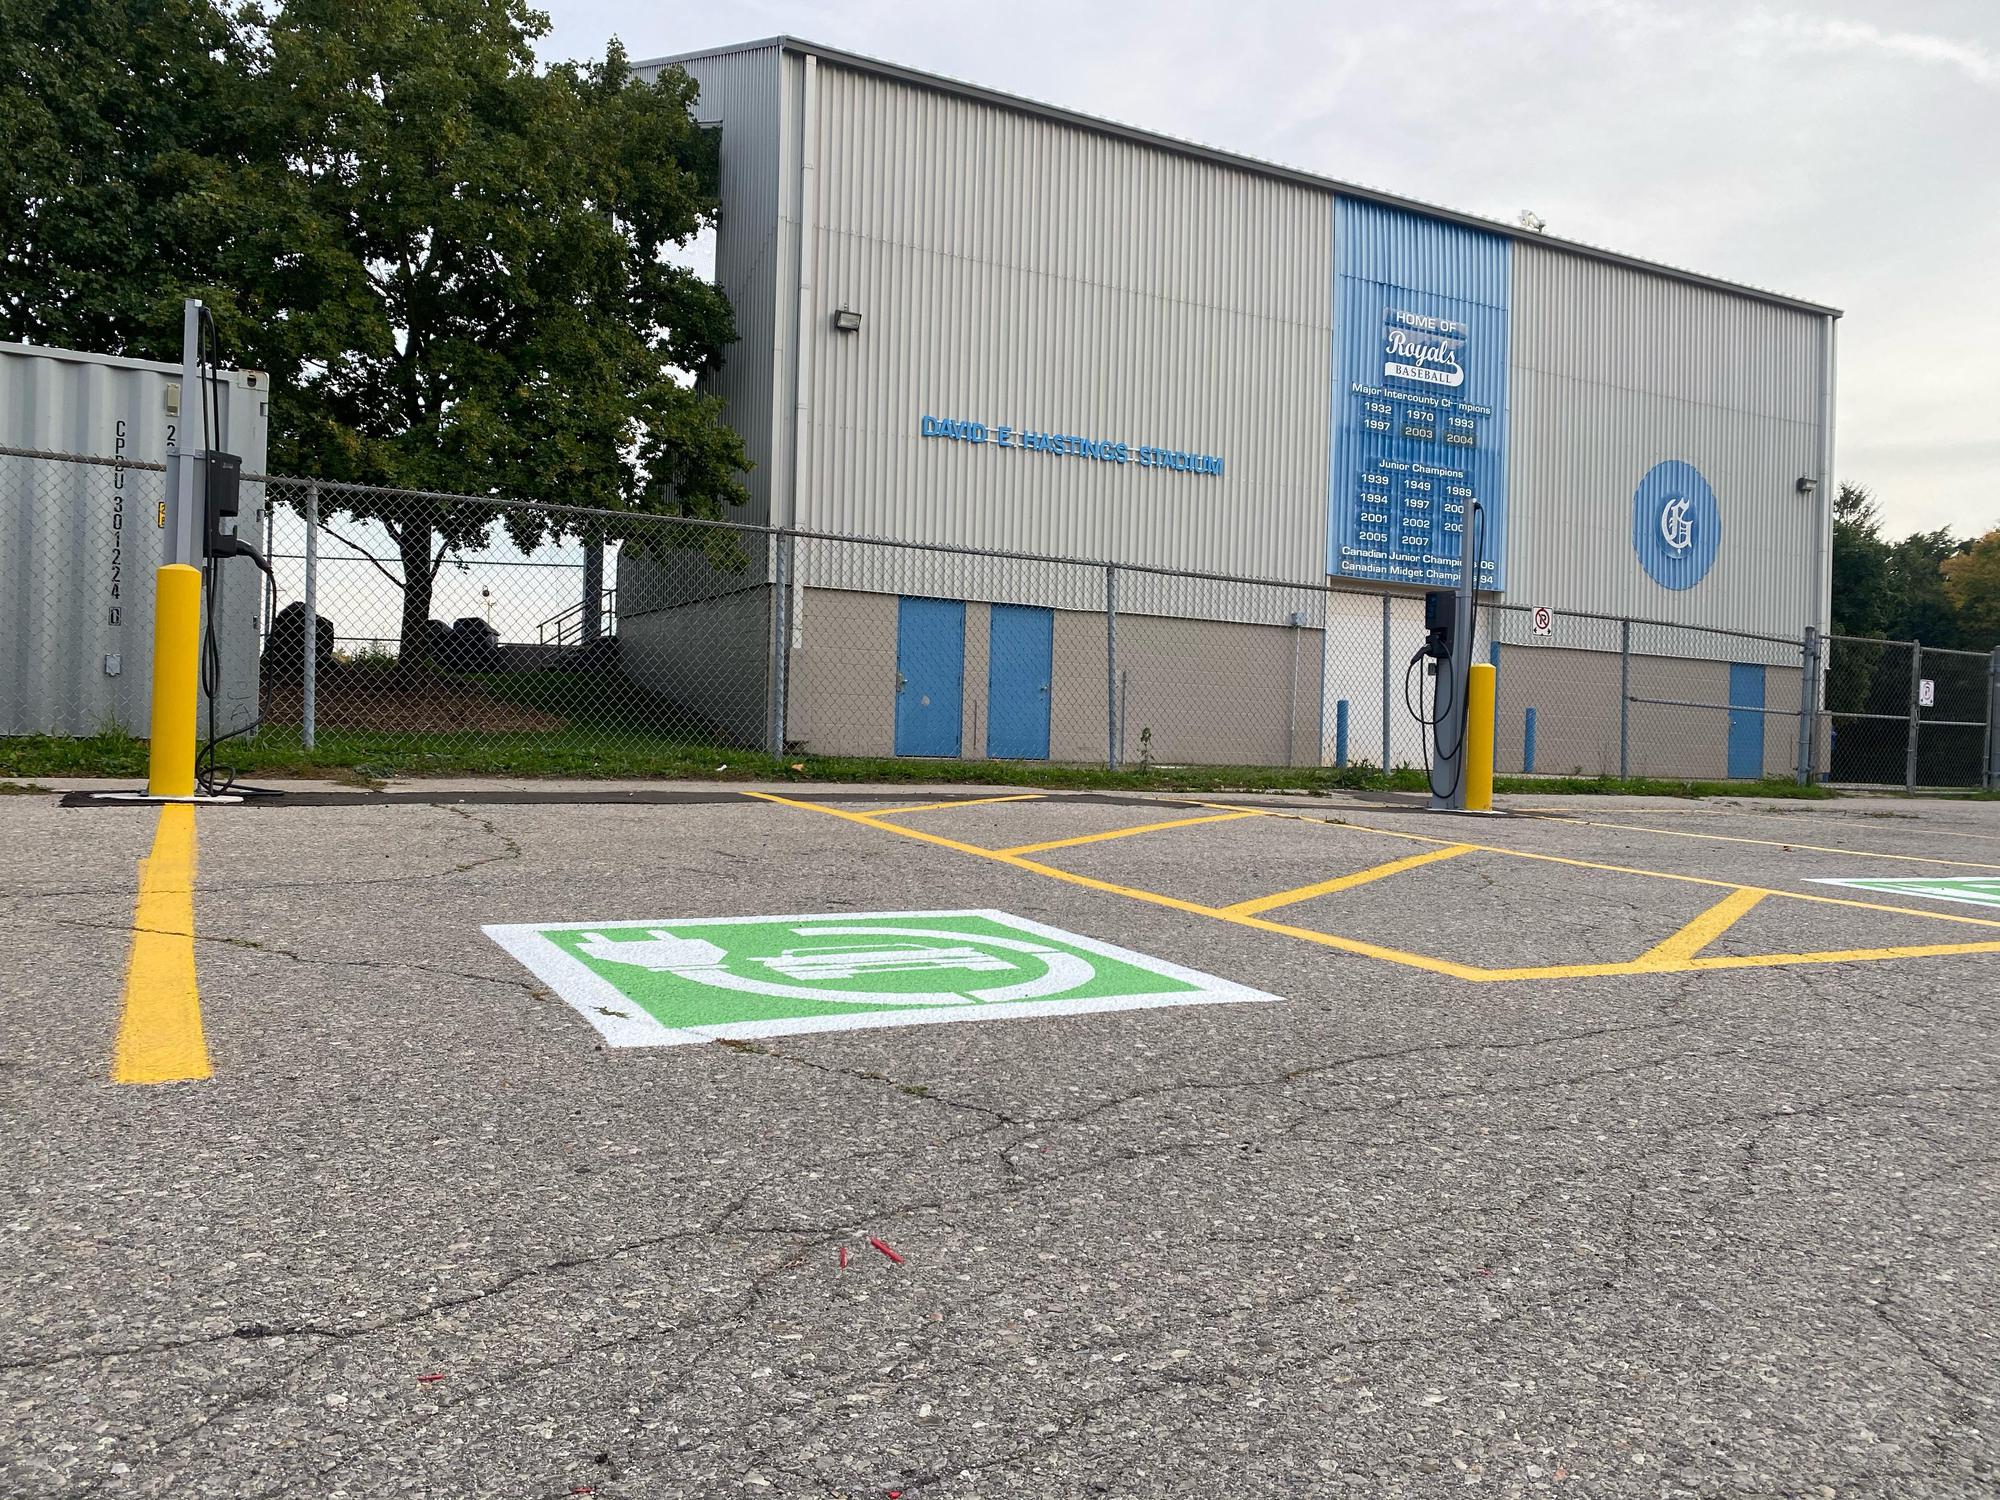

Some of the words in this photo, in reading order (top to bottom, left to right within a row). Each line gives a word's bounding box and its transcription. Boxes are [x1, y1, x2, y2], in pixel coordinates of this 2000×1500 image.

[1396, 312, 1436, 330] HOME
[1440, 320, 1457, 333] OF
[1386, 331, 1455, 366] Royals
[1395, 365, 1451, 383] BASEBALL
[1352, 383, 1382, 397] Major
[1384, 388, 1440, 408] Intercounty
[1441, 398, 1491, 415] Chmpions
[1364, 401, 1392, 415] 1932
[1406, 409, 1434, 422] 1970
[1448, 416, 1475, 430] 1993
[1364, 418, 1390, 431] 1997
[1405, 427, 1433, 439] 2003
[1447, 434, 1473, 445] 2004
[921, 415, 988, 443] DAVID
[1022, 430, 1129, 464] HASTINGS
[1139, 445, 1225, 477] STADIUM
[1379, 459, 1410, 472] Junior
[1412, 463, 1464, 479] Champions
[1361, 473, 1389, 486] 1939
[1404, 479, 1431, 492] 1949
[1446, 485, 1472, 498] 1989
[1360, 492, 1388, 506] 1994
[1404, 498, 1430, 510] 1997
[1444, 503, 1465, 514] 200
[1360, 512, 1388, 524] 2001
[1402, 517, 1430, 530] 2002
[1444, 522, 1464, 533] 200
[1359, 531, 1388, 543] 2005
[1401, 535, 1429, 547] 2007
[1341, 546, 1388, 560] Canadian
[1389, 551, 1421, 564] Junior
[1480, 560, 1495, 571] 06
[1341, 560, 1387, 574] Canadian
[1389, 565, 1424, 579] Midget
[1480, 574, 1494, 585] 94
